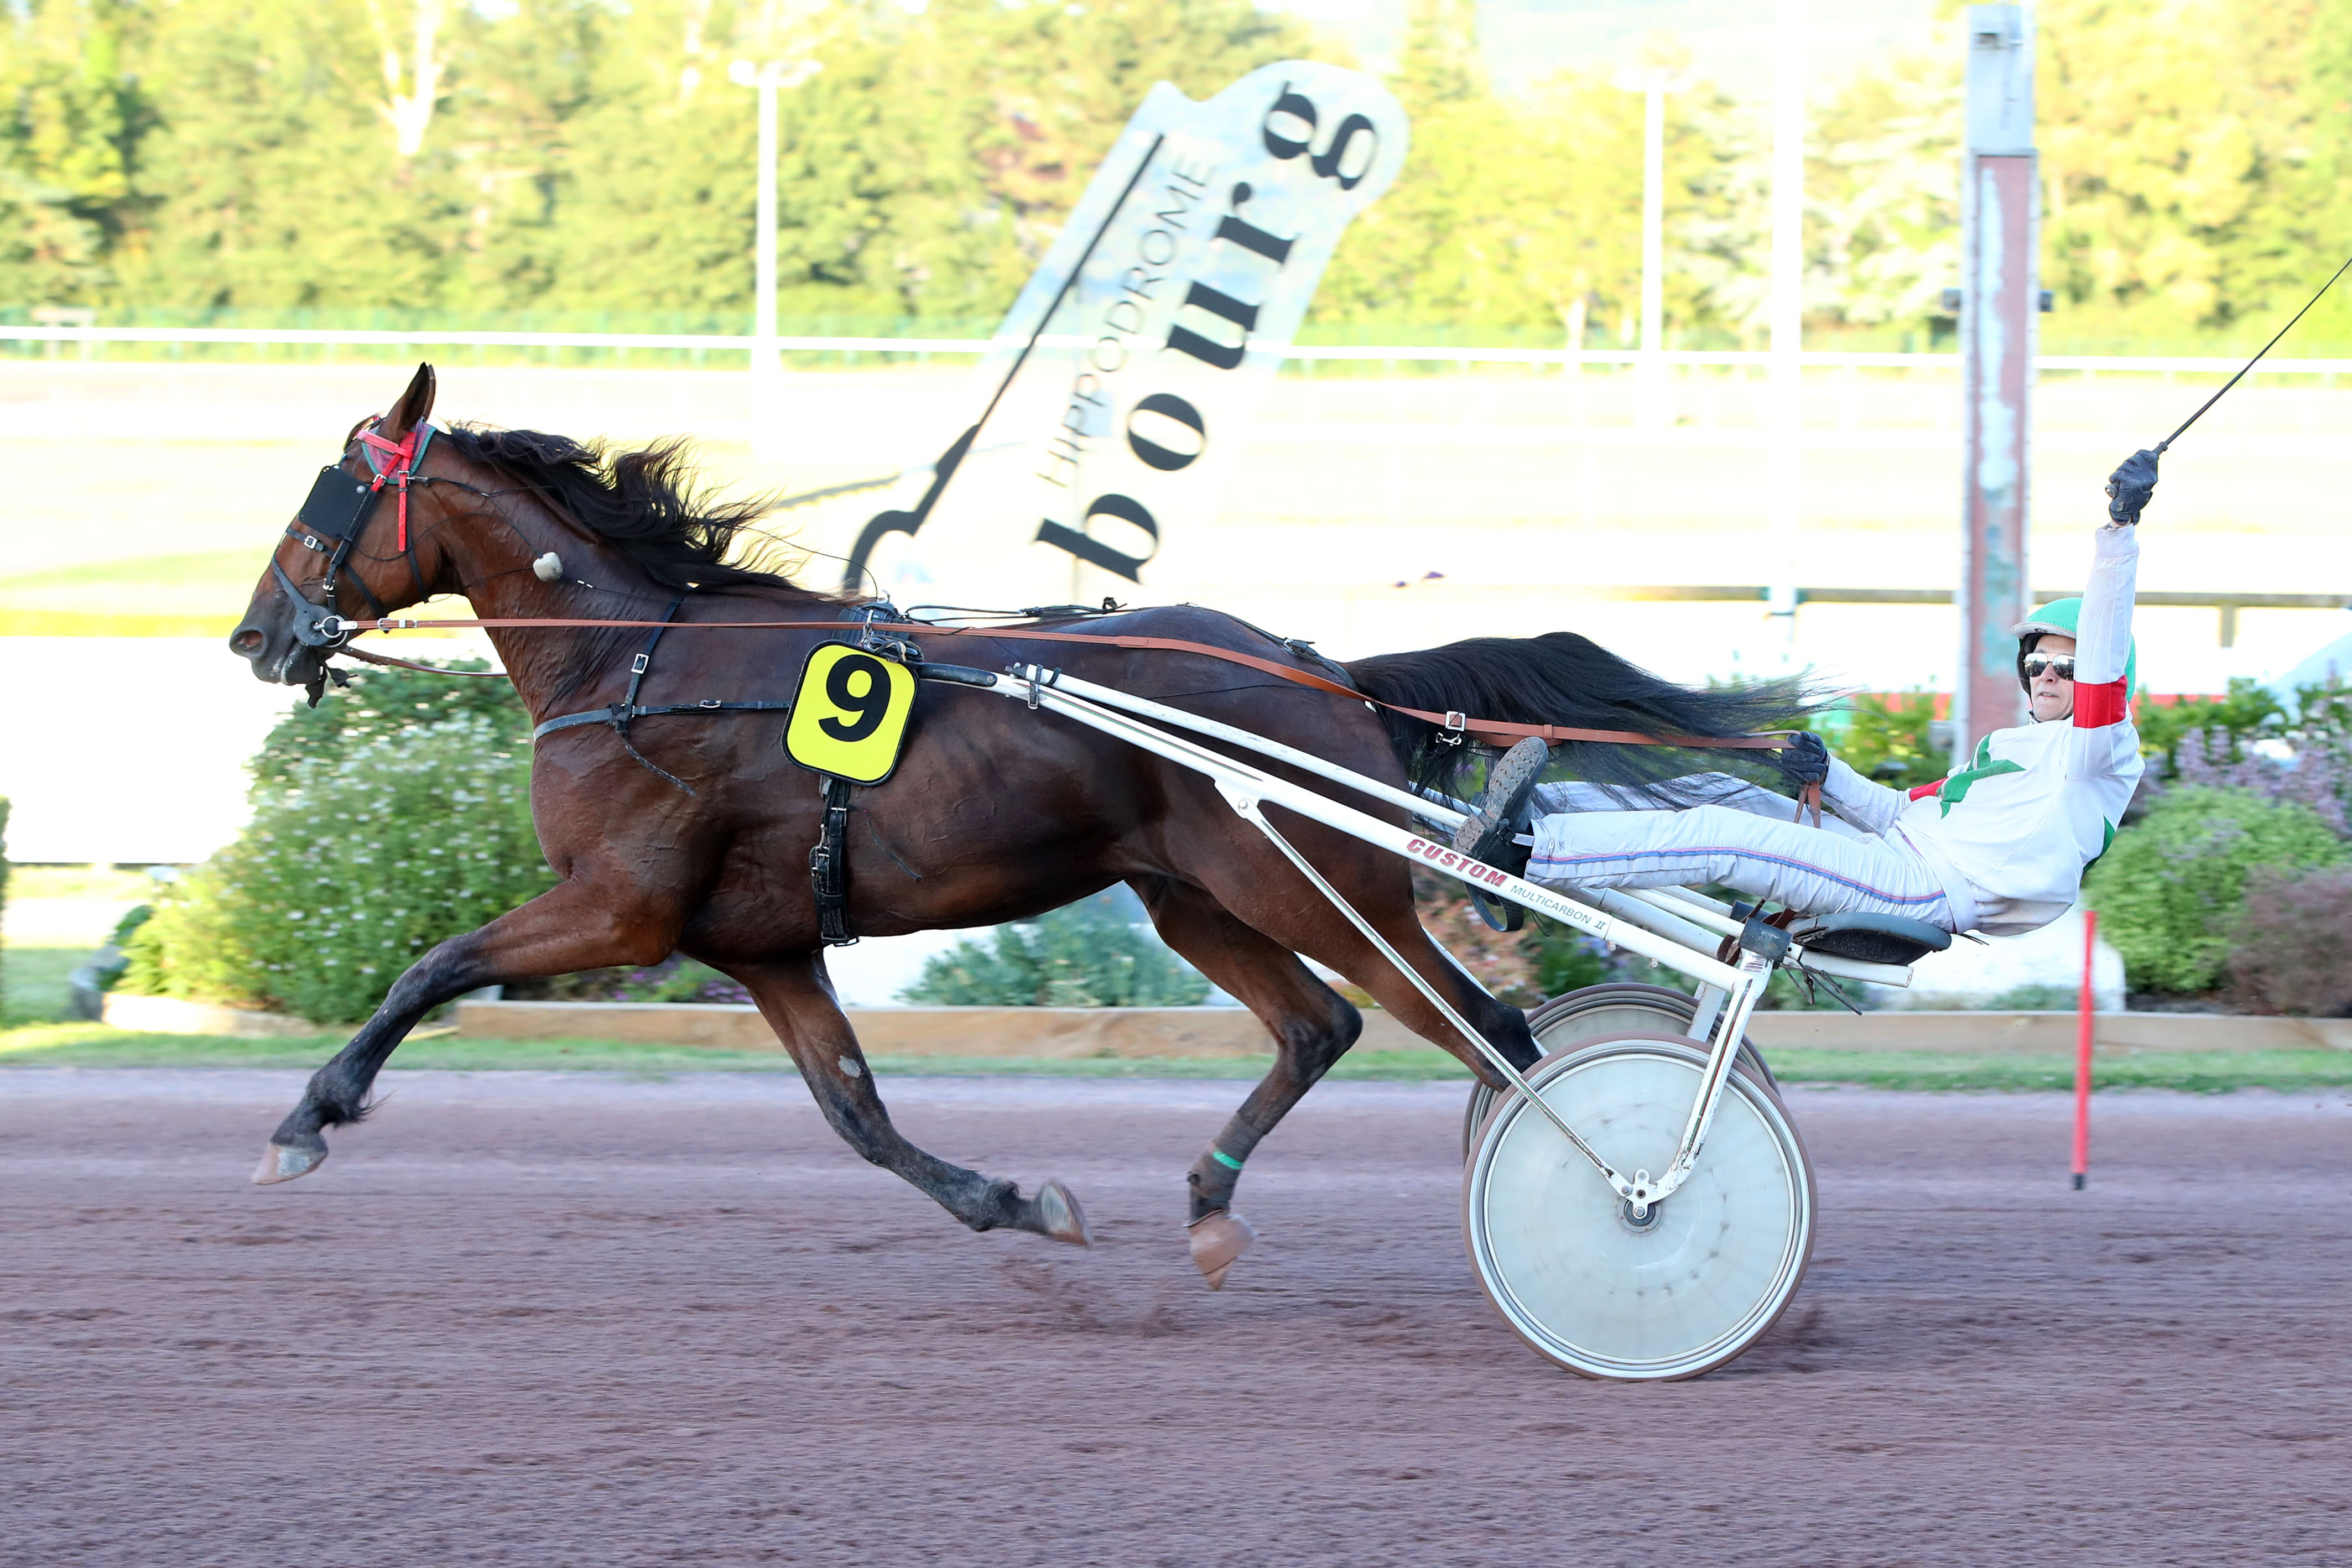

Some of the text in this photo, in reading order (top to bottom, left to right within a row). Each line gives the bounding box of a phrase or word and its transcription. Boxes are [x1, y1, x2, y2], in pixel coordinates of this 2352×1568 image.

[1029, 81, 1378, 586] bourg
[1035, 153, 1217, 488] HIPPODROME
[818, 654, 891, 742] 9
[1407, 838, 1607, 930] CUSTOM MULTICARBON II
